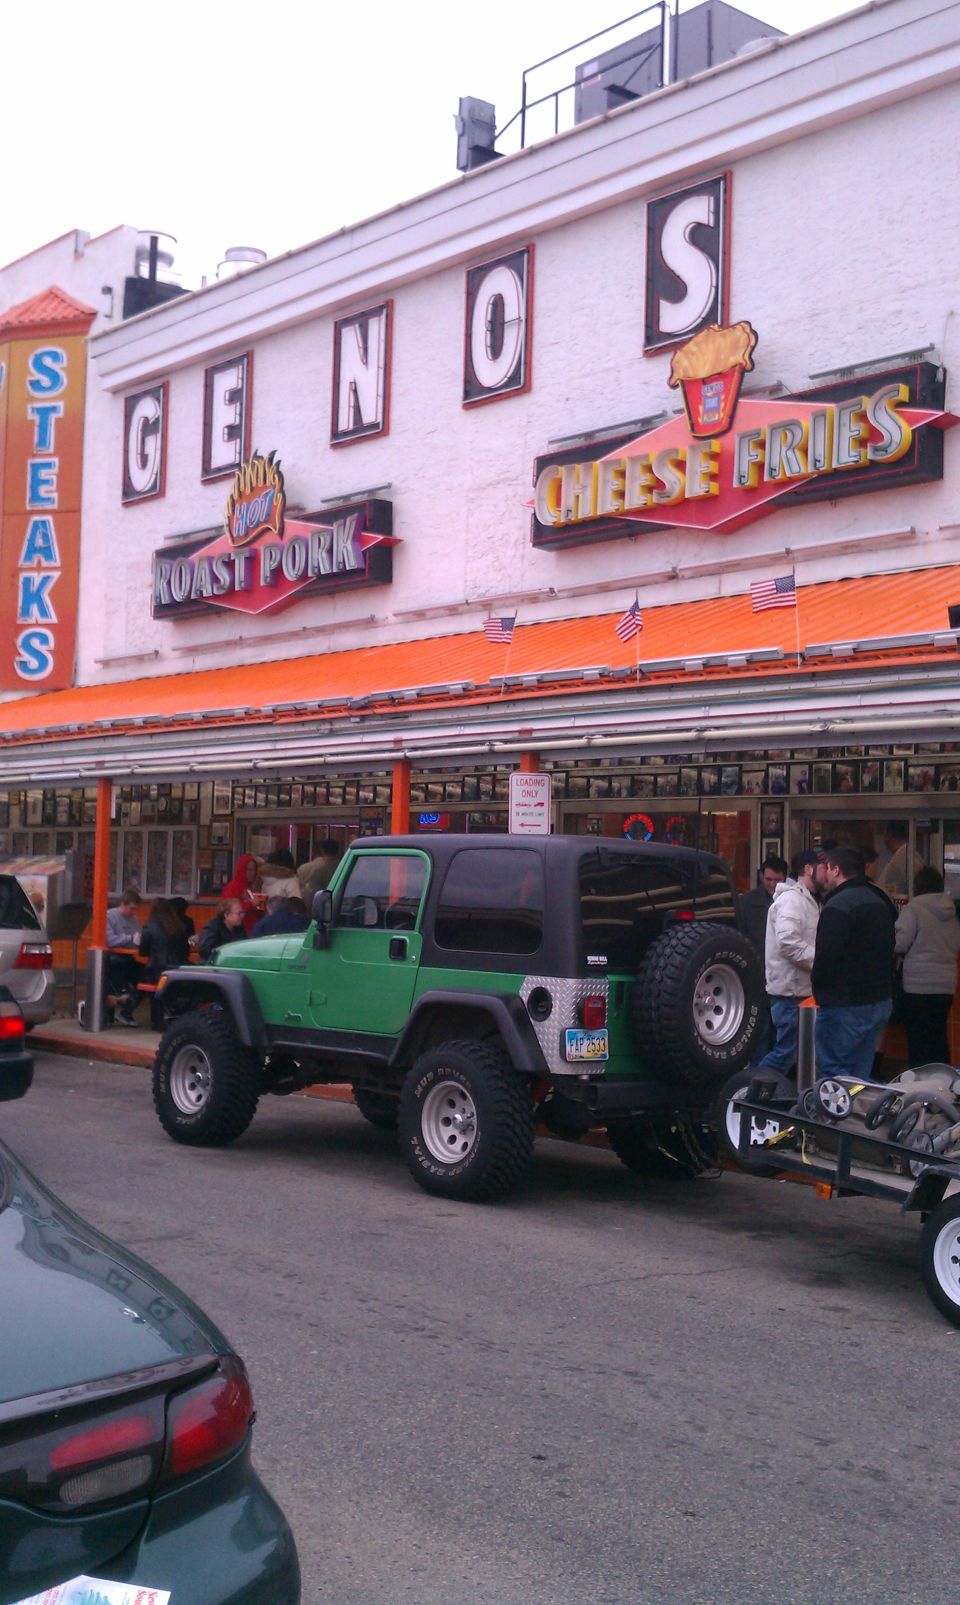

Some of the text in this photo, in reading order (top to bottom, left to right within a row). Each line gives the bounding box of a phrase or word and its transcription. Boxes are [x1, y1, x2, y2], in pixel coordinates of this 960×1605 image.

[534, 383, 913, 528] CHEESE FRIES
[14, 345, 68, 682] STEAKS
[233, 487, 275, 537] HOT
[153, 512, 367, 606] ROAST PORK
[515, 778, 545, 788] LOADING
[521, 790, 539, 798] ONLY
[586, 1037, 606, 1053] 2533
